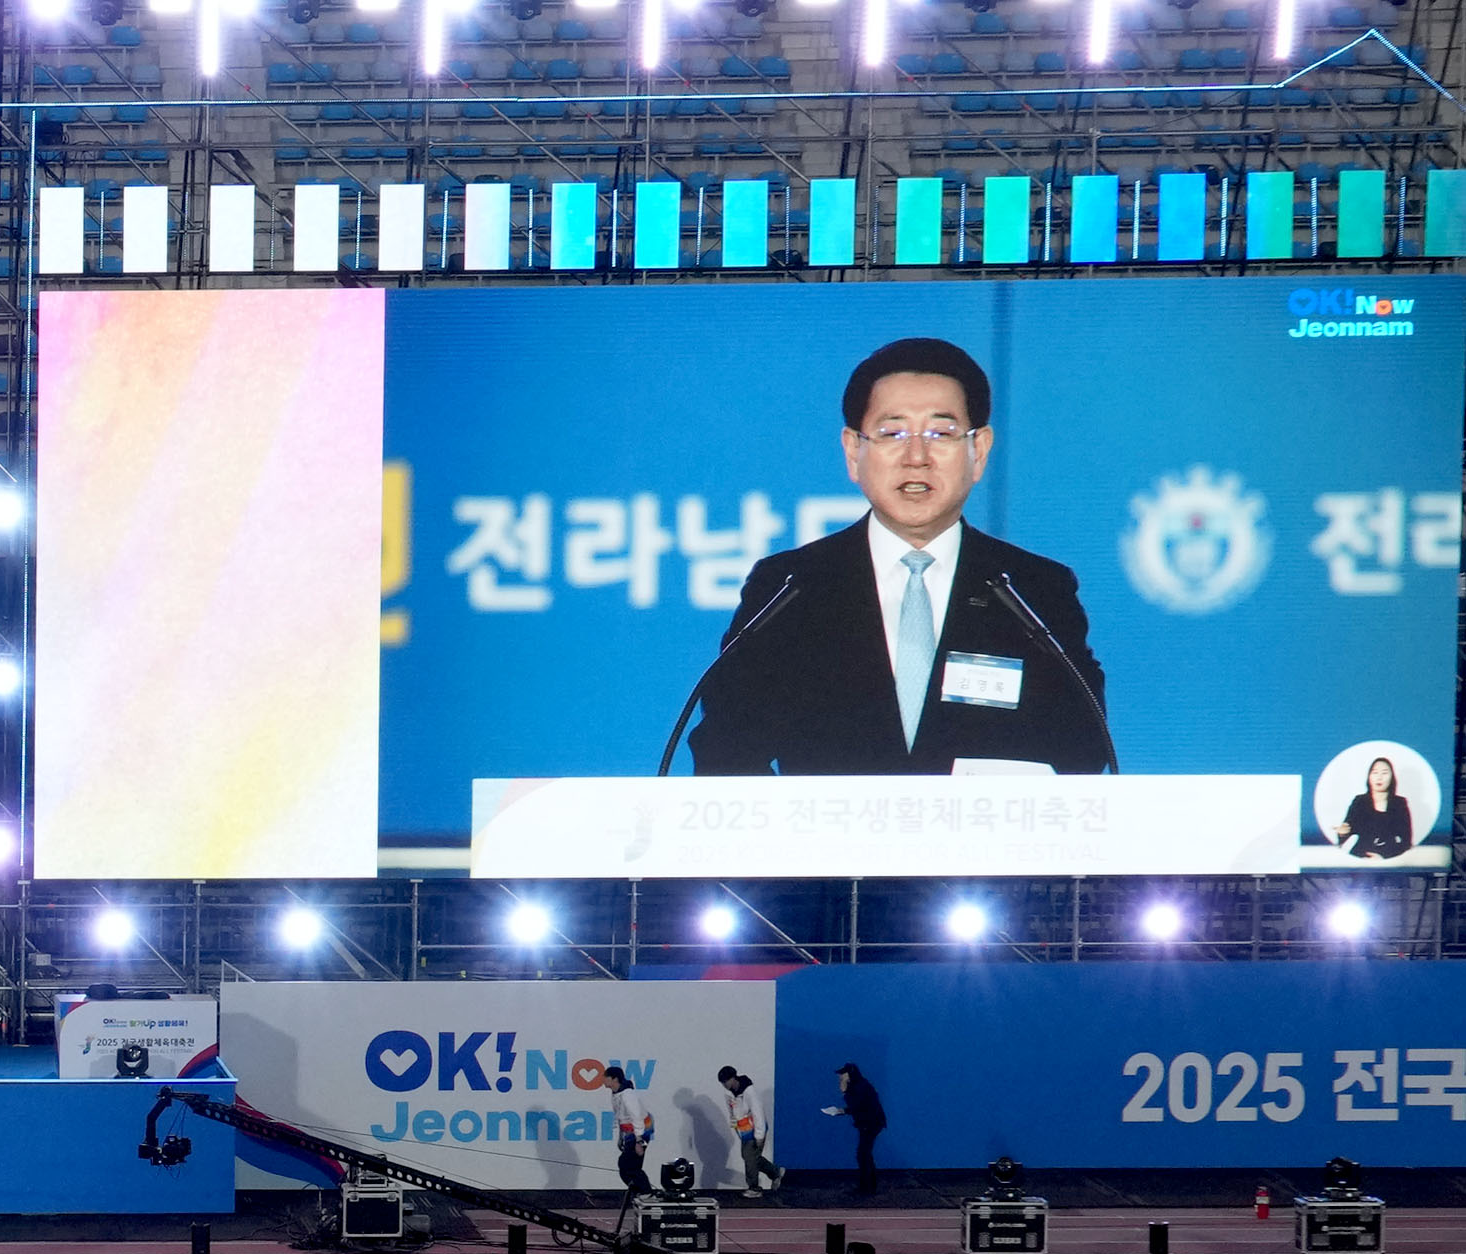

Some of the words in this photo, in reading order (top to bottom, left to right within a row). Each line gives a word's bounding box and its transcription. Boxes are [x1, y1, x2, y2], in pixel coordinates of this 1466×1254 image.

[1287, 287, 1353, 318] OK!
[1354, 294, 1415, 316] Now
[1287, 316, 1414, 339] Jeonnam
[678, 798, 770, 831] 2025
[784, 794, 1110, 835] 전국생활체육대축전
[96, 1038, 118, 1047] 2025
[365, 1029, 518, 1093] OK!
[525, 1049, 656, 1091] Now
[1121, 1051, 1307, 1124] 2025
[1332, 1047, 1466, 1124] 전국
